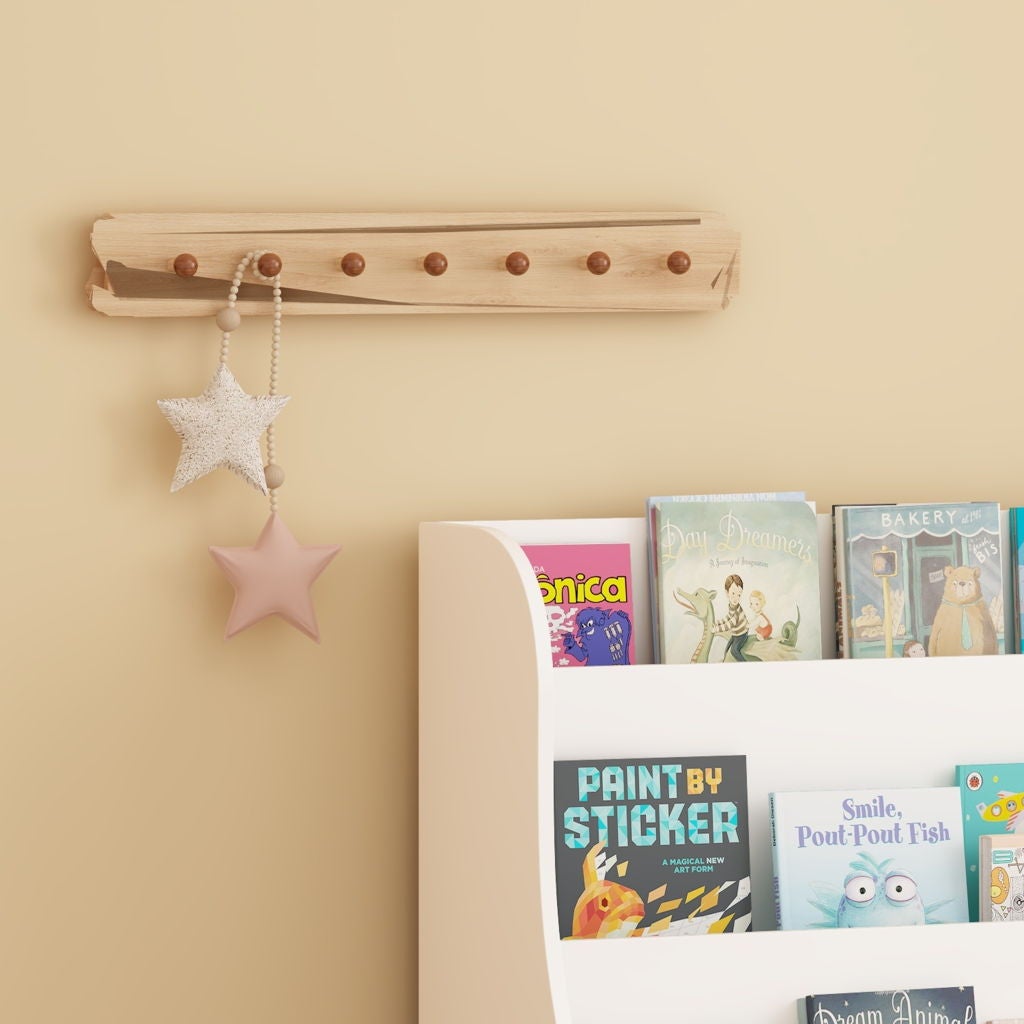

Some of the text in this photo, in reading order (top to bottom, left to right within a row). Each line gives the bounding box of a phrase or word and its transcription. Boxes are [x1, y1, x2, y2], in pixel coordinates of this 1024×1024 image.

[881, 510, 957, 528] BAKERY
[660, 509, 812, 565] Day Dreamers
[578, 764, 722, 802] PAINT BY
[842, 795, 903, 821] Smile,
[564, 801, 739, 849] STICKER
[794, 821, 951, 849] Pout-Pout Fish
[670, 858, 705, 866] MAGICAL
[674, 865, 714, 874] ART FORM
